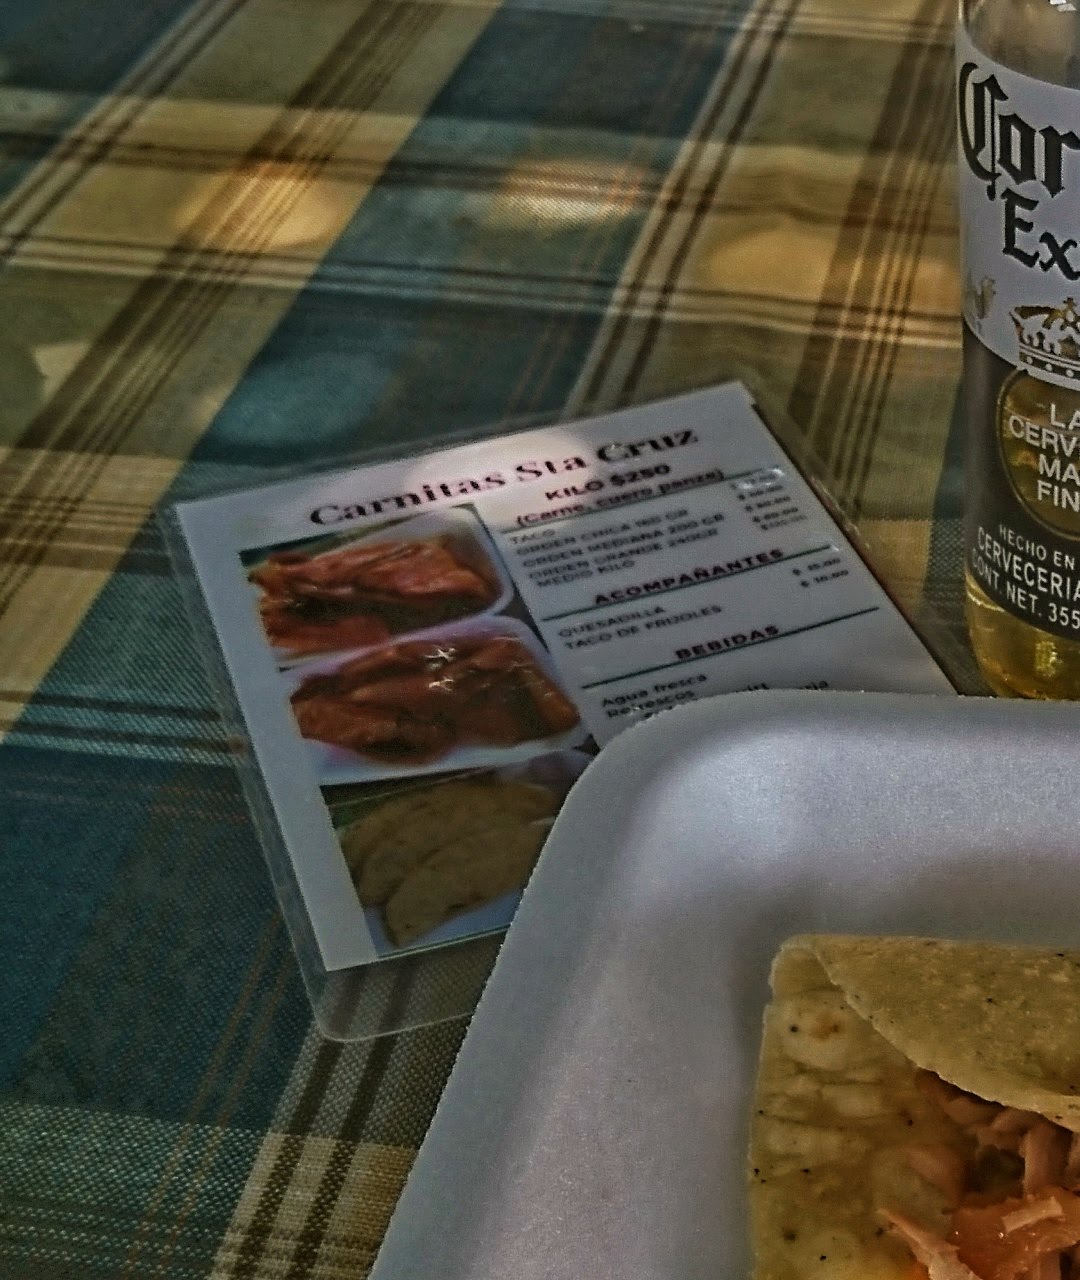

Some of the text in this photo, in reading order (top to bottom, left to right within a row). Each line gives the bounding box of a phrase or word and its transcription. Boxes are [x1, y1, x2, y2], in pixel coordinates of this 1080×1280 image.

[310, 429, 698, 525] Carnitas Sta Cruz
[545, 480, 604, 500] KILO
[1000, 524, 1047, 561] HECHO
[1053, 551, 1075, 571] EN
[1006, 581, 1042, 617] NET.
[675, 625, 780, 660] BEBIDAS
[602, 673, 708, 708] Agua fresca
